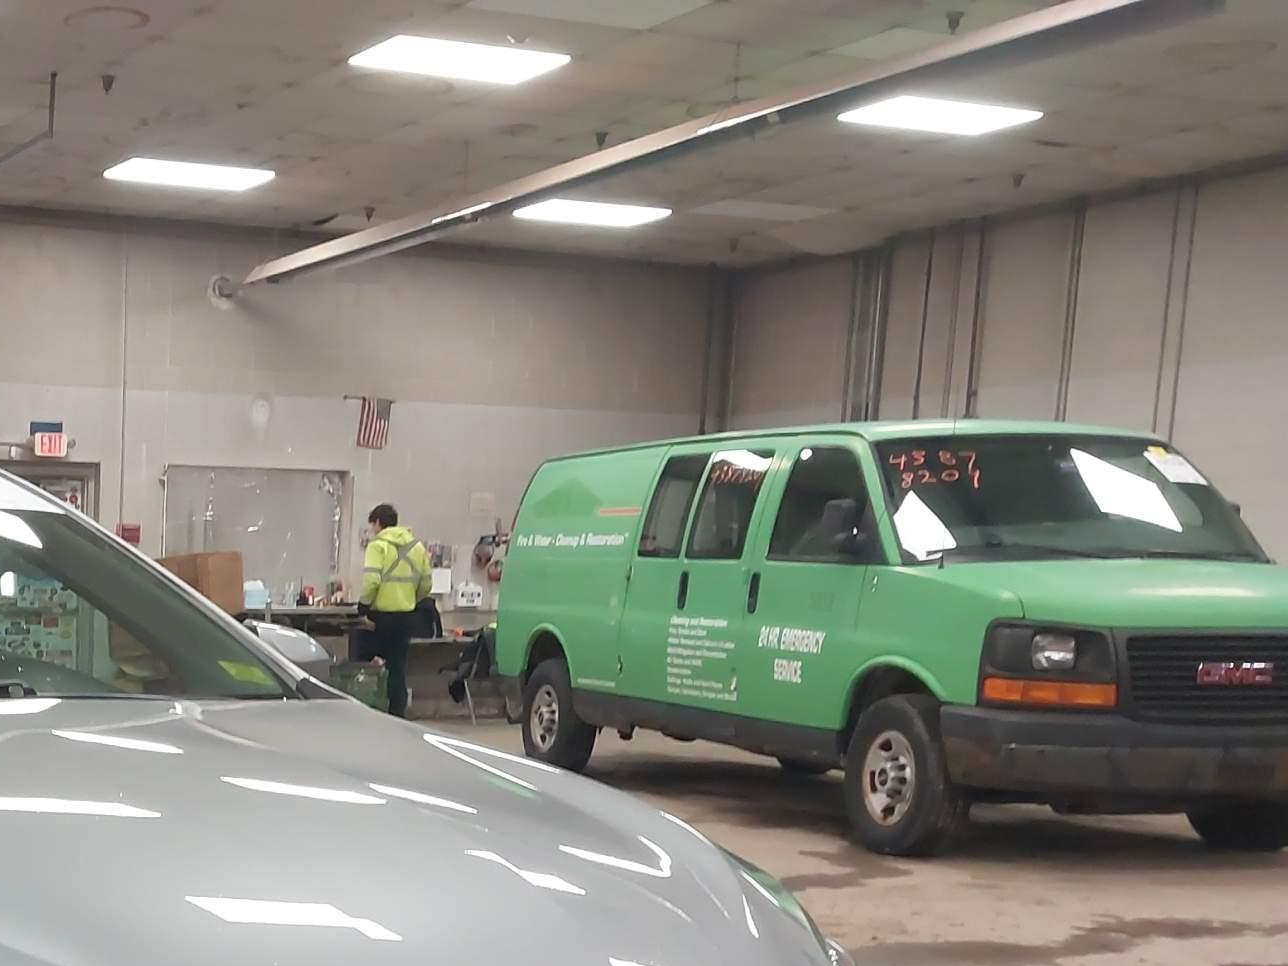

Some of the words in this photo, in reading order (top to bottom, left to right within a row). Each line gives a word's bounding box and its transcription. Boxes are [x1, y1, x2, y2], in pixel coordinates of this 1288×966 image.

[40, 434, 62, 454] EXIT
[758, 625, 769, 647] 24
[780, 627, 826, 654] EMERGENCY
[774, 658, 802, 684] SERVICE
[1197, 662, 1273, 684] GMC
